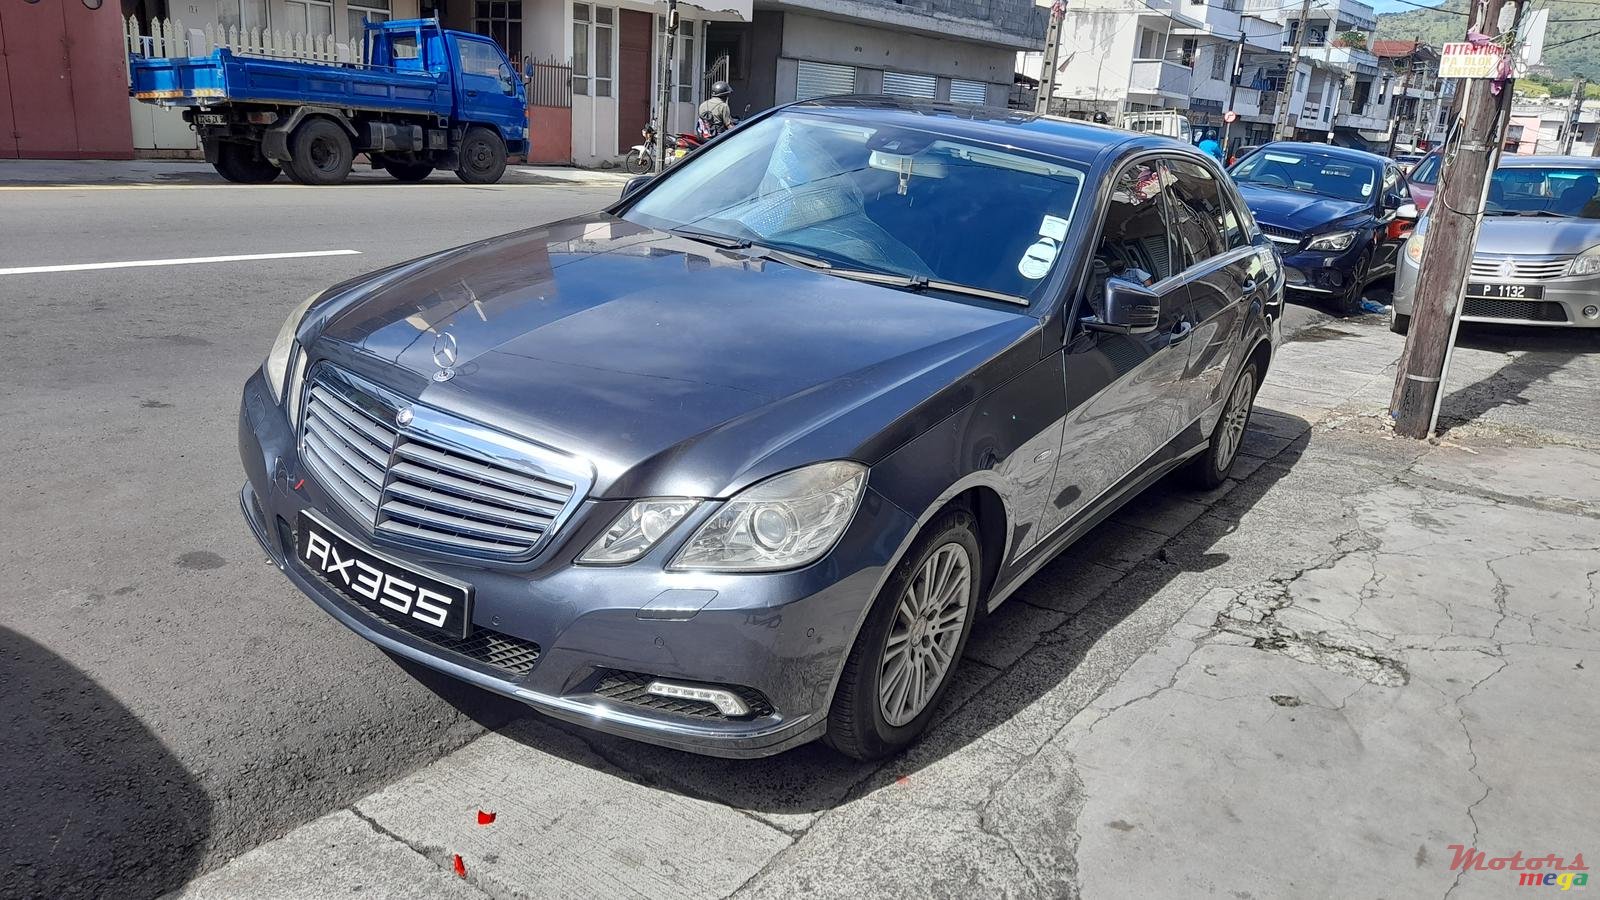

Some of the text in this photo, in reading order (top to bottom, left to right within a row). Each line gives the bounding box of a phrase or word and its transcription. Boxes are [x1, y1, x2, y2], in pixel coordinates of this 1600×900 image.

[1442, 56, 1492, 65] PA BLOK
[1483, 285, 1525, 298] P 1132
[306, 530, 452, 628] AX355
